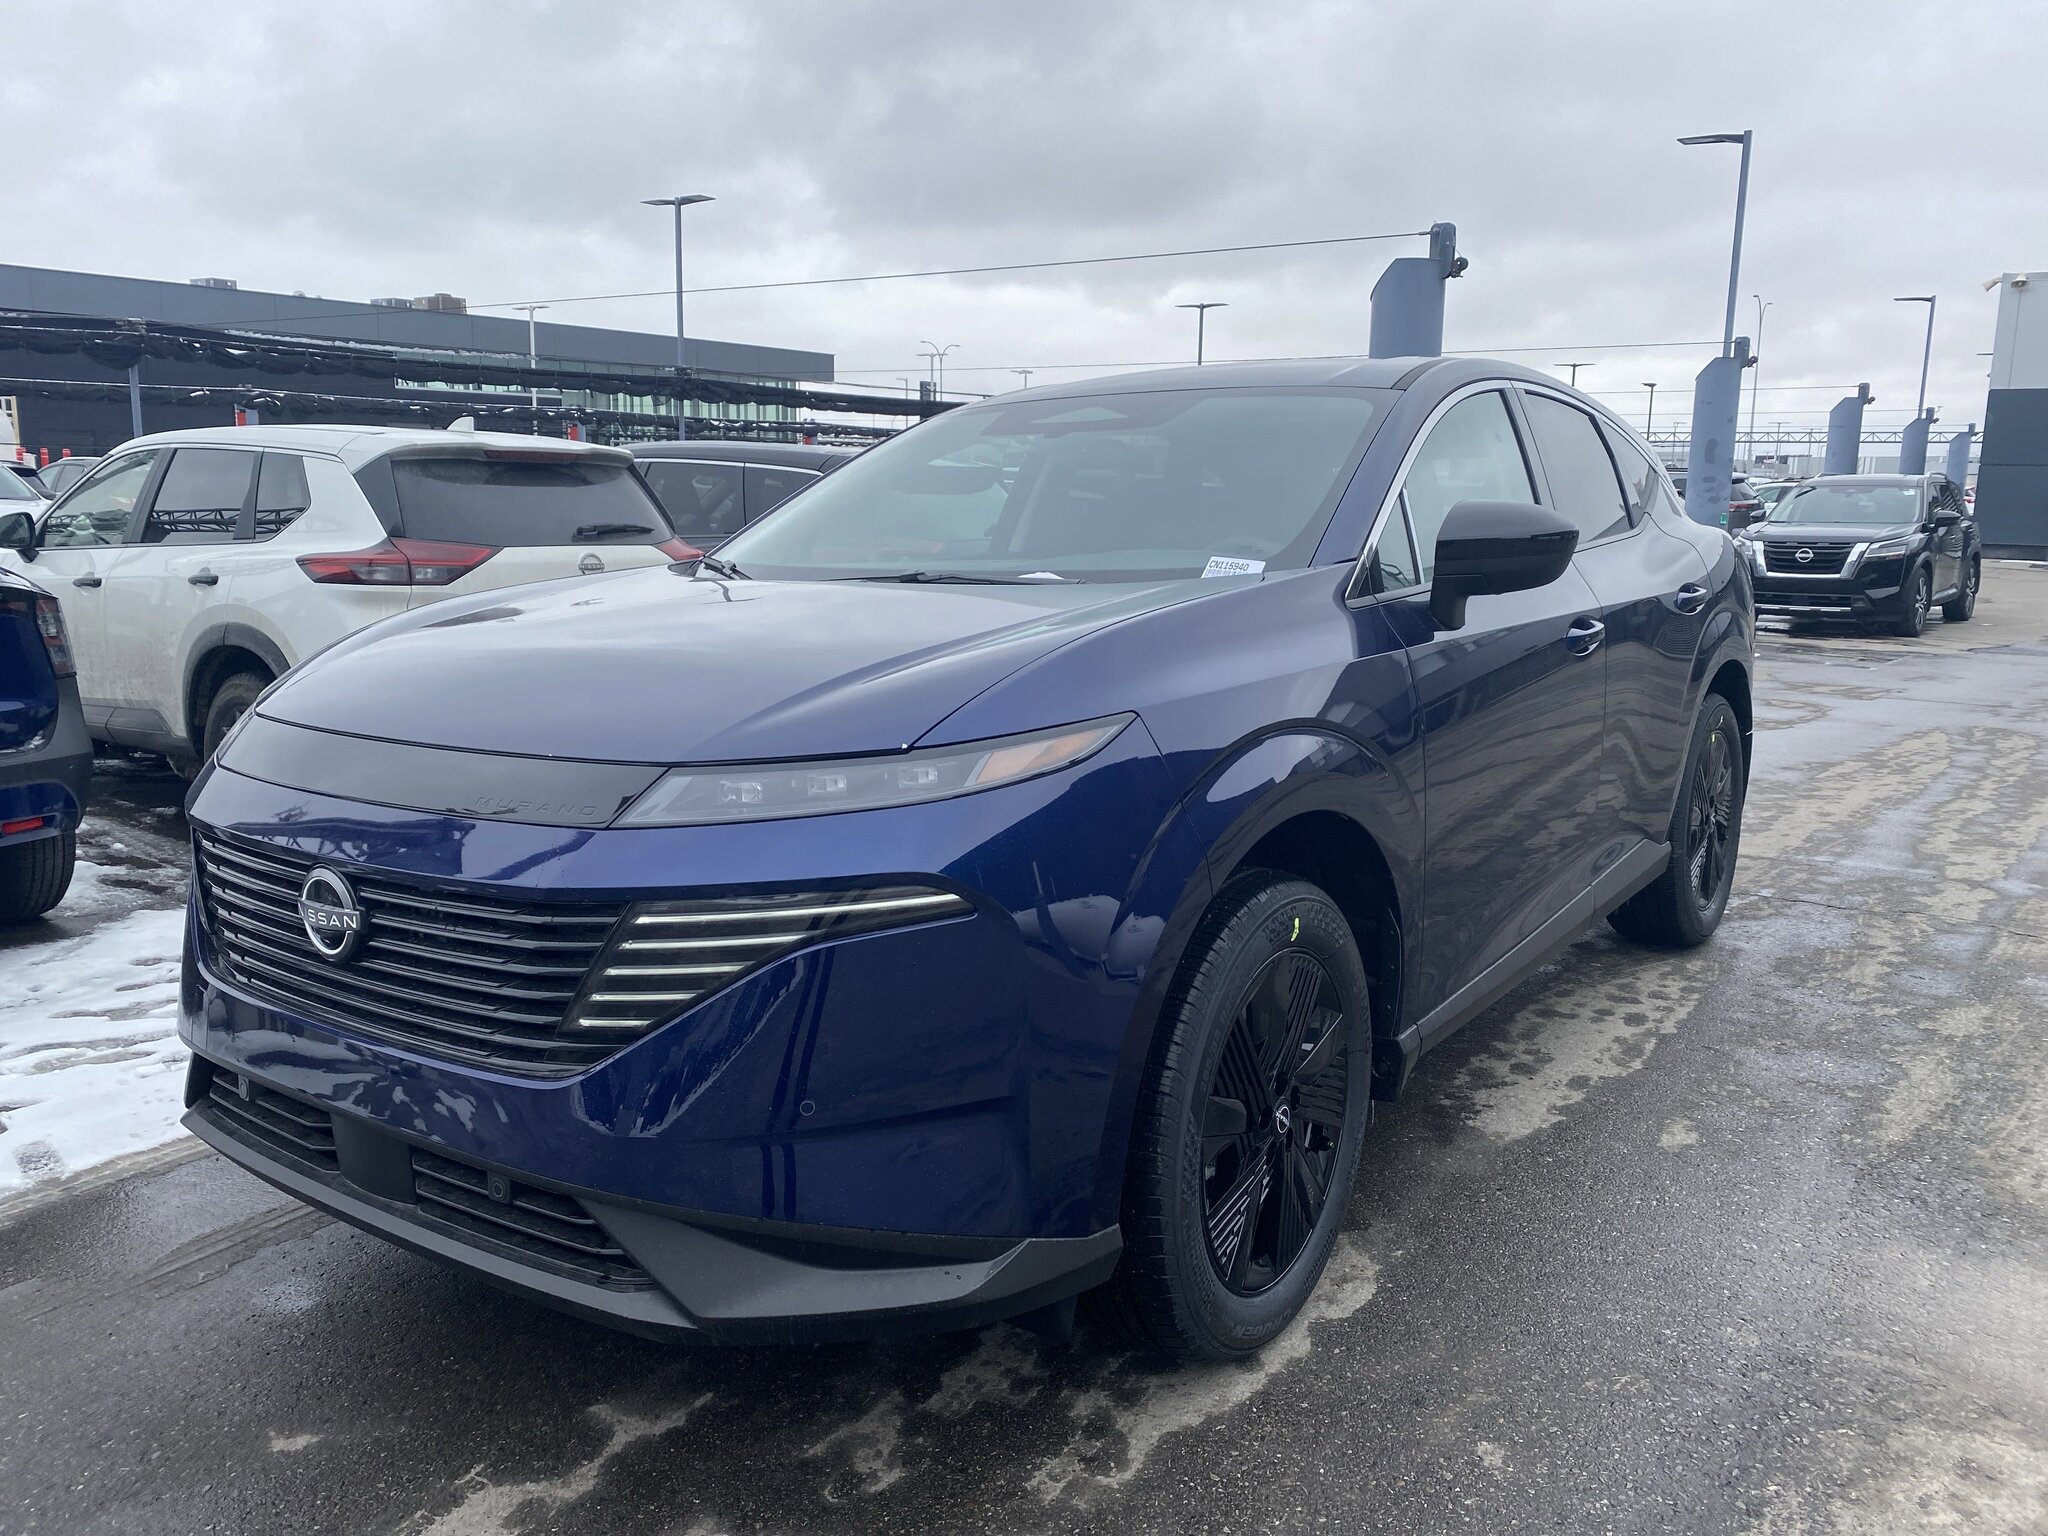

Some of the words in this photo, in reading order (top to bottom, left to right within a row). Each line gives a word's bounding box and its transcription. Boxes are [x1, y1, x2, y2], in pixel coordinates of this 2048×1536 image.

[1208, 560, 1250, 572] CN115940
[474, 796, 598, 817] MURANO
[303, 905, 357, 929] SSAN
